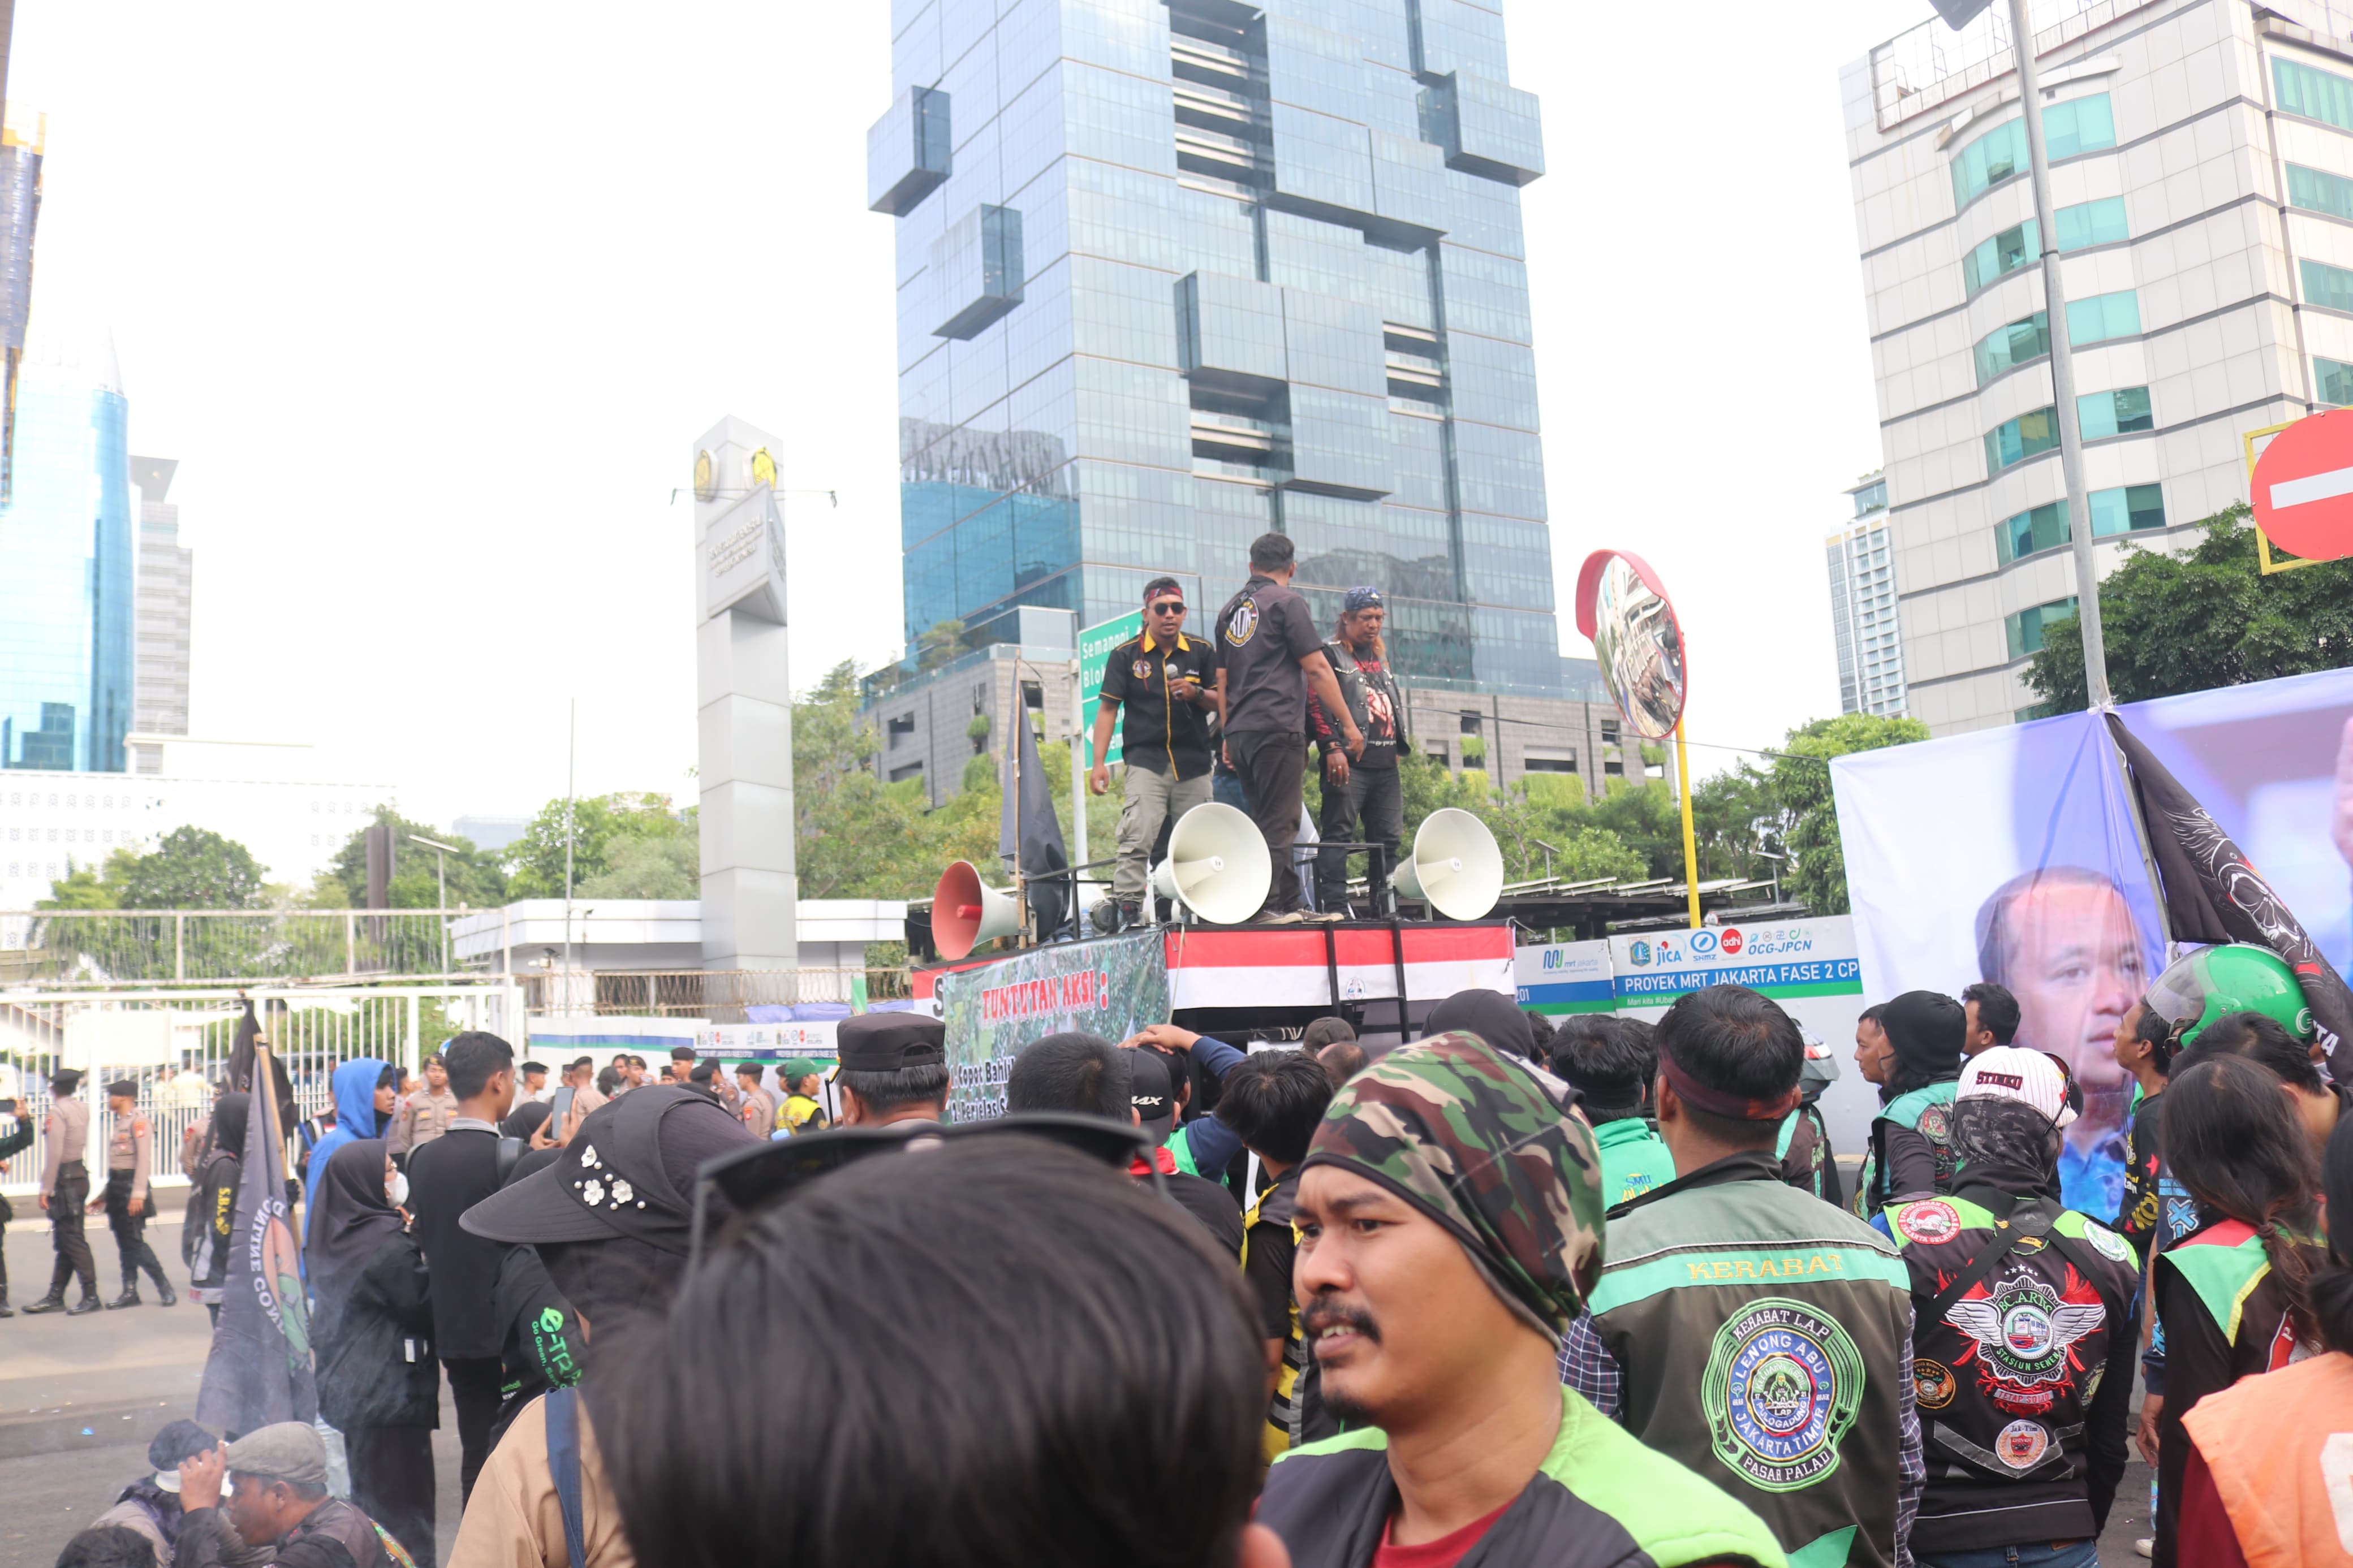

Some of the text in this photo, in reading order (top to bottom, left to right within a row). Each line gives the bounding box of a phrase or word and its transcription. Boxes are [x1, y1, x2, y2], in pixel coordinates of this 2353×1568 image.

[1748, 940, 1812, 955] OCG-JPCN
[1624, 975, 1677, 992] PROYEK
[1680, 972, 1708, 988] MRT
[1712, 968, 1777, 987] JAKARTA
[1781, 965, 1821, 982] FASE
[1825, 963, 1834, 979] 2
[982, 977, 1058, 1020] TUNTUTAN
[1061, 969, 1096, 1008] AKSI
[1686, 1254, 1843, 1280] KERABAT
[1732, 1309, 1830, 1342] KERABAT LAP
[1735, 1334, 1826, 1380] LENONG ABU
[1996, 1347, 2060, 1371] STASIUN SENEN
[1998, 1391, 2024, 1403] TETAP
[1756, 1399, 1808, 1428] PULOGADUNG
[1735, 1407, 1825, 1455] JAKARTA TIMUR
[1743, 1450, 1831, 1481] PASAR PALAD
